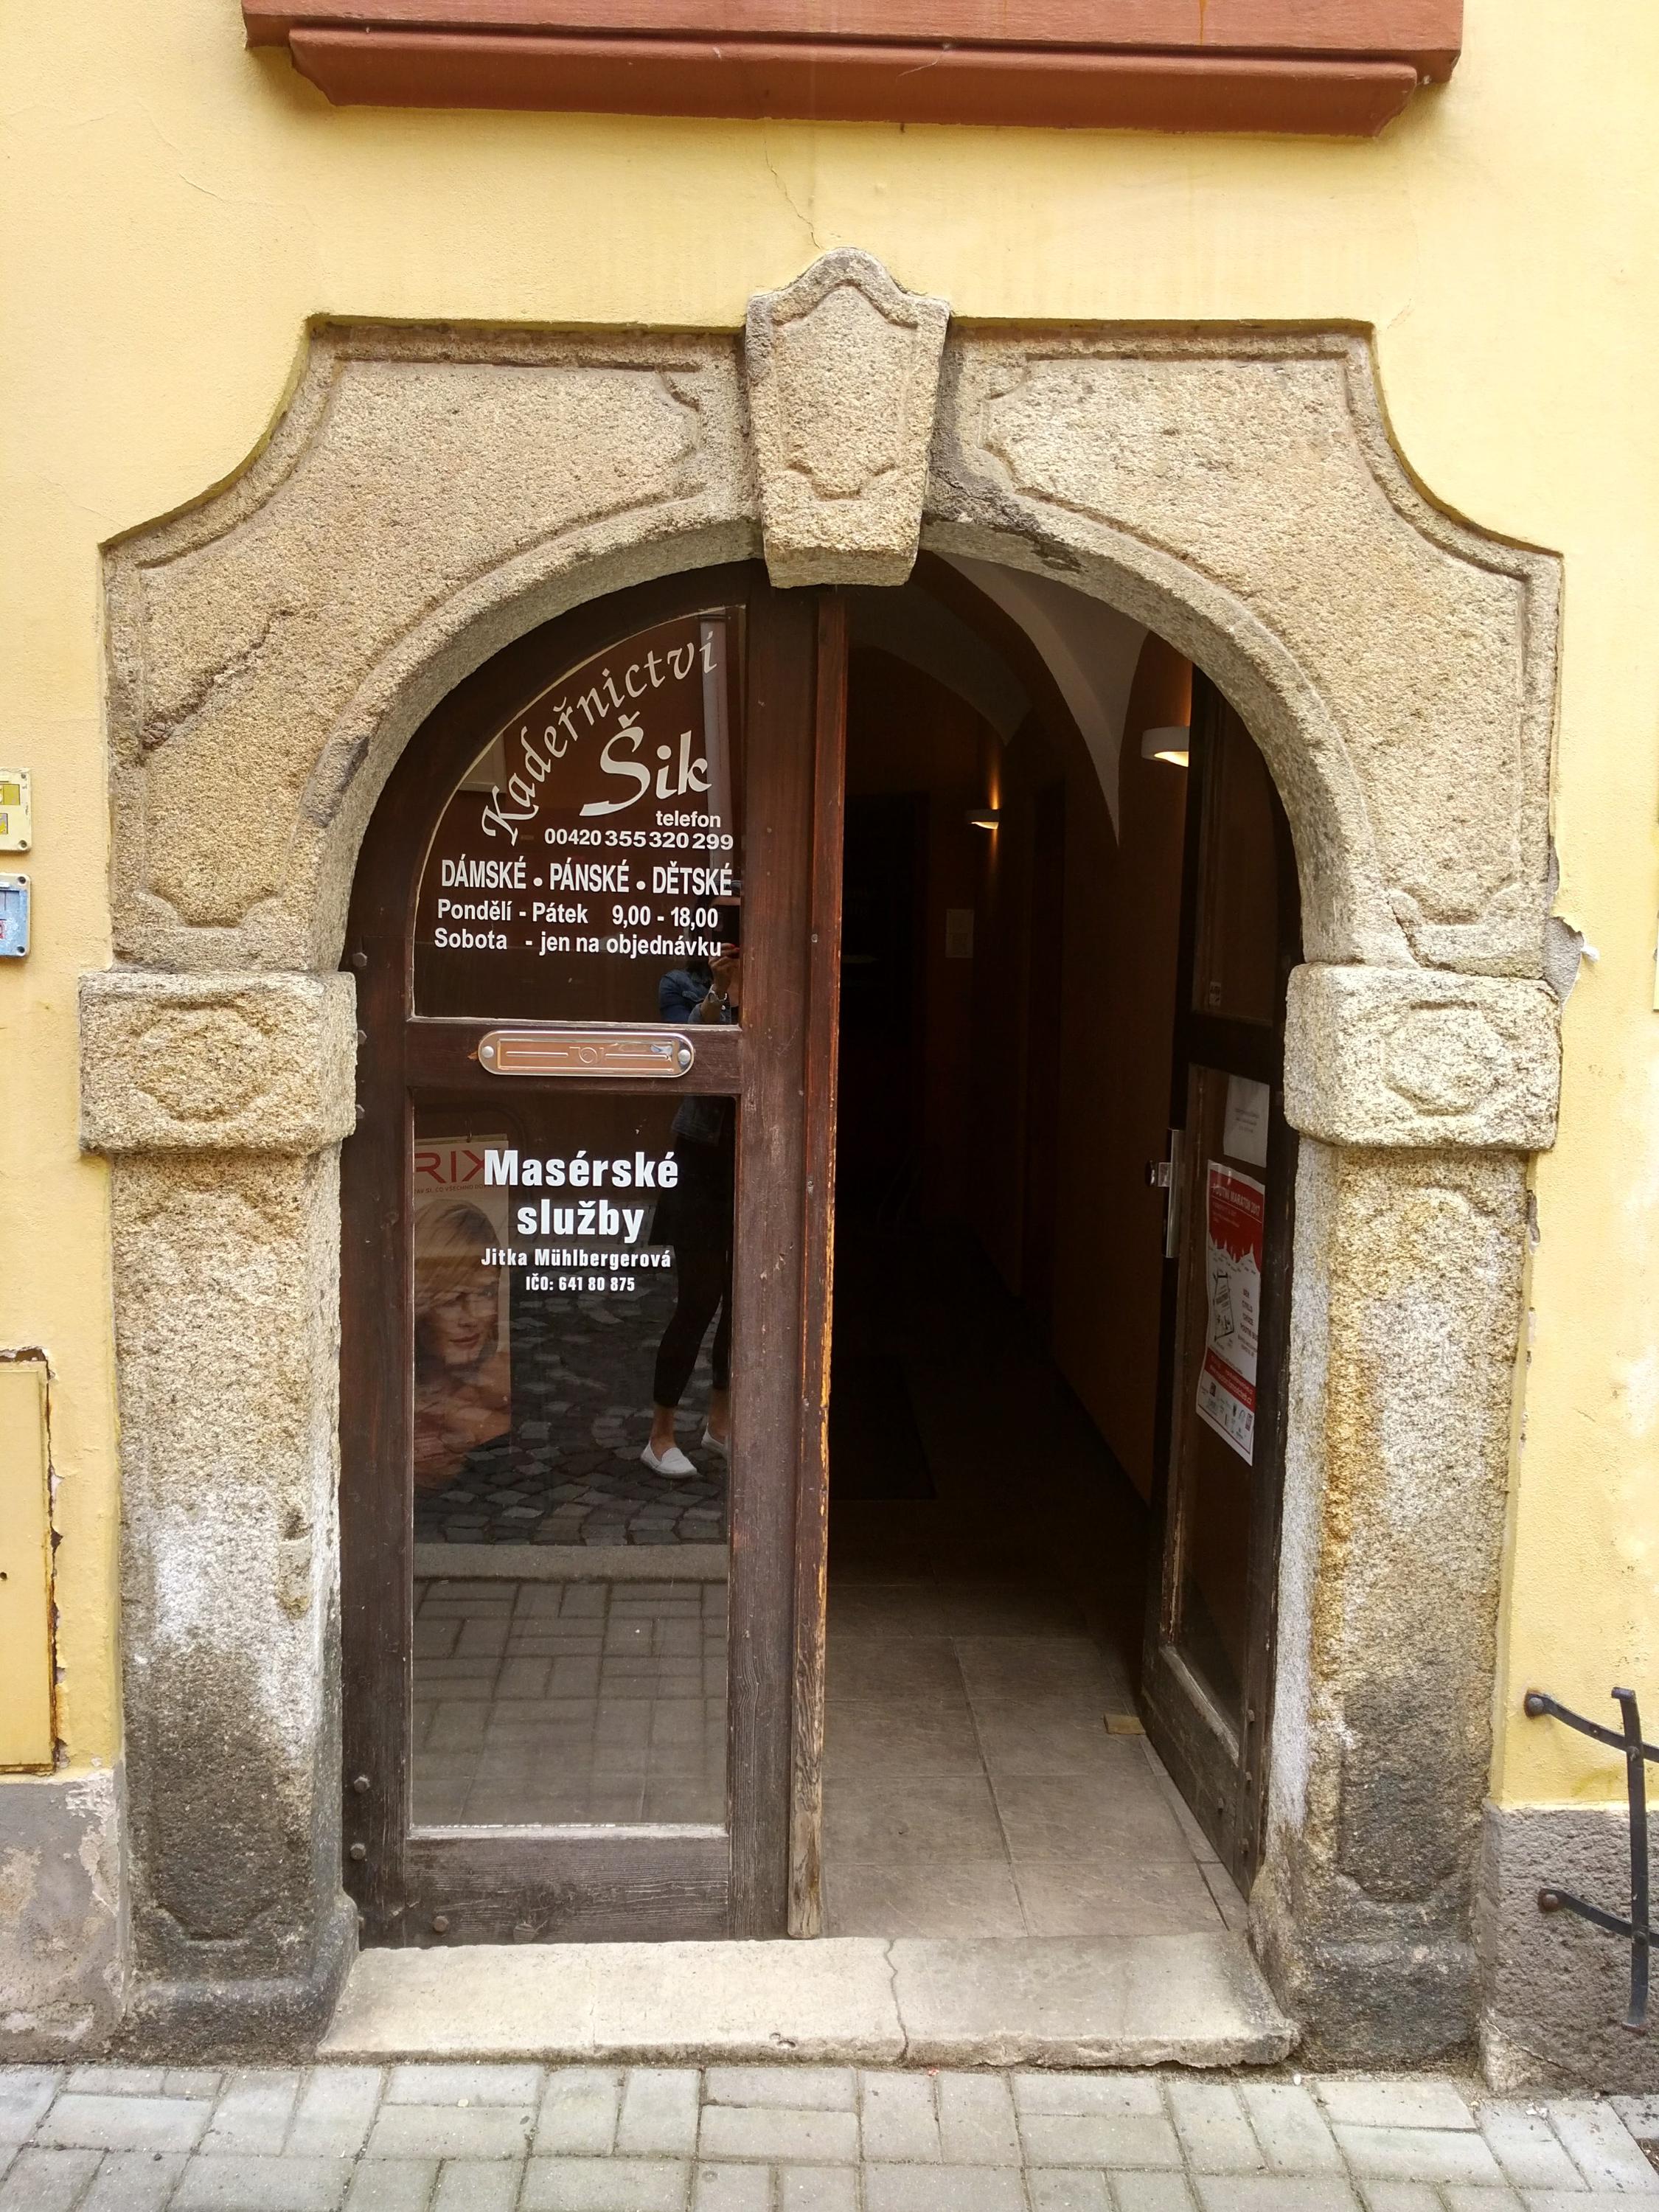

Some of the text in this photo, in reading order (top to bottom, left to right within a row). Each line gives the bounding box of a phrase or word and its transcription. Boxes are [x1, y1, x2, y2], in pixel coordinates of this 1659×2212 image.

[481, 630, 717, 846] Kadeřnictví
[579, 711, 713, 817] Šik
[655, 810, 721, 828] telefon
[544, 828, 734, 850] 00420 355 320 299
[442, 853, 733, 897] DÁMSKÉ PÁNSKÉ DĚTSKÉ
[438, 898, 512, 921] Pondělí
[532, 902, 588, 924] Pátek
[612, 904, 651, 929] 9,00
[670, 906, 719, 931] 18,00
[434, 927, 508, 950] Sobota
[538, 931, 570, 956] jen
[576, 936, 599, 953] na
[606, 933, 722, 959] objednávku
[484, 1150, 678, 1189] Masérské
[517, 1199, 644, 1244] služby
[481, 1248, 672, 1271] Jitka Mühlbergerová
[525, 1273, 636, 1292] IČO: 641 80 875
